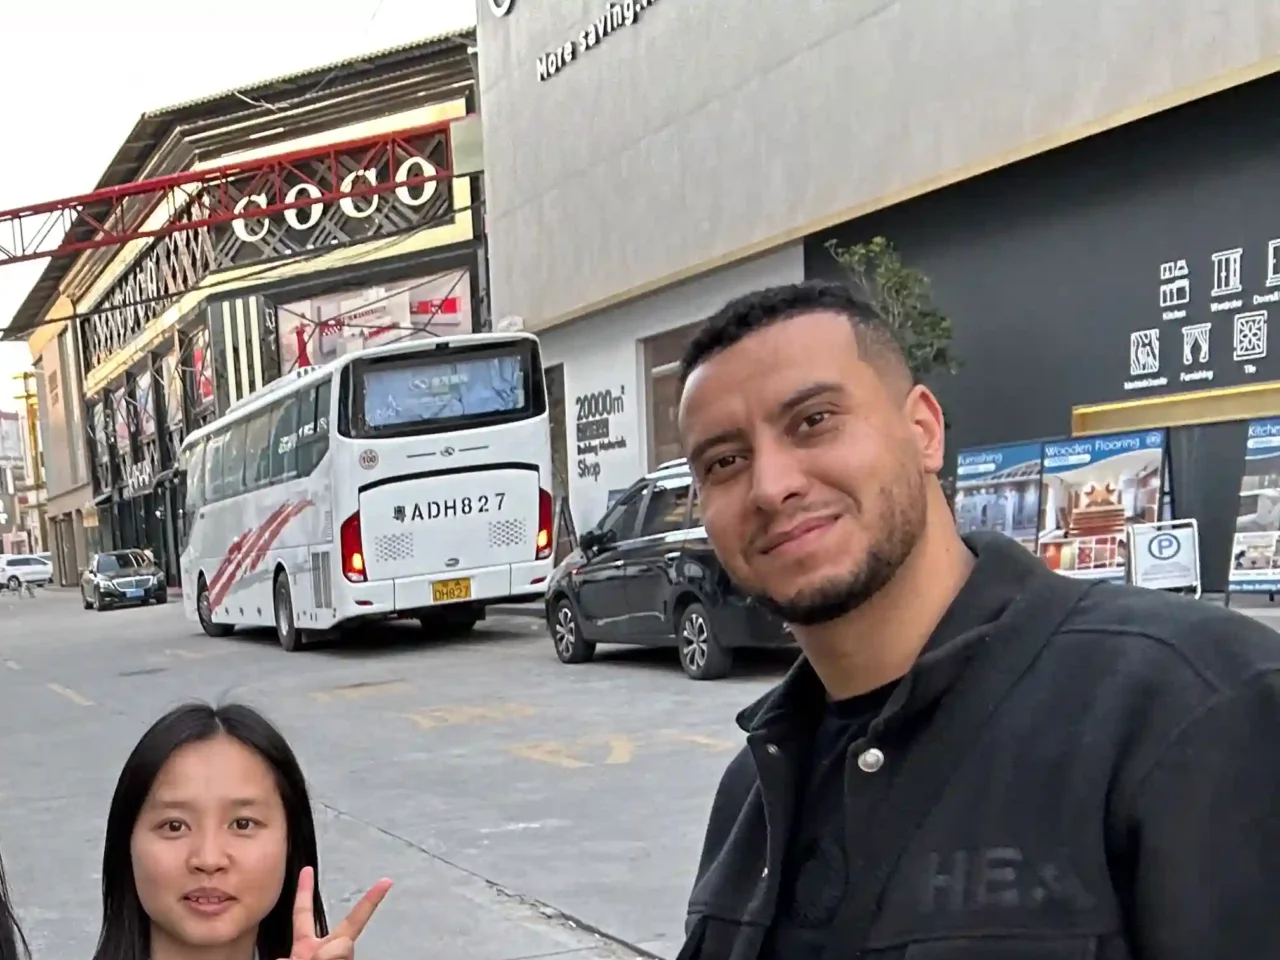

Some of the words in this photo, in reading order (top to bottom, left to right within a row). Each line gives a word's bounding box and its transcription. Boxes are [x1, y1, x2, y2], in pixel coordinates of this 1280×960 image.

[536, 40, 574, 82] More
[1045, 443, 1092, 457] Wooden
[1094, 436, 1140, 452] Flooring
[577, 458, 601, 482] Shop
[1157, 537, 1174, 556] P
[434, 586, 469, 601] DH827
